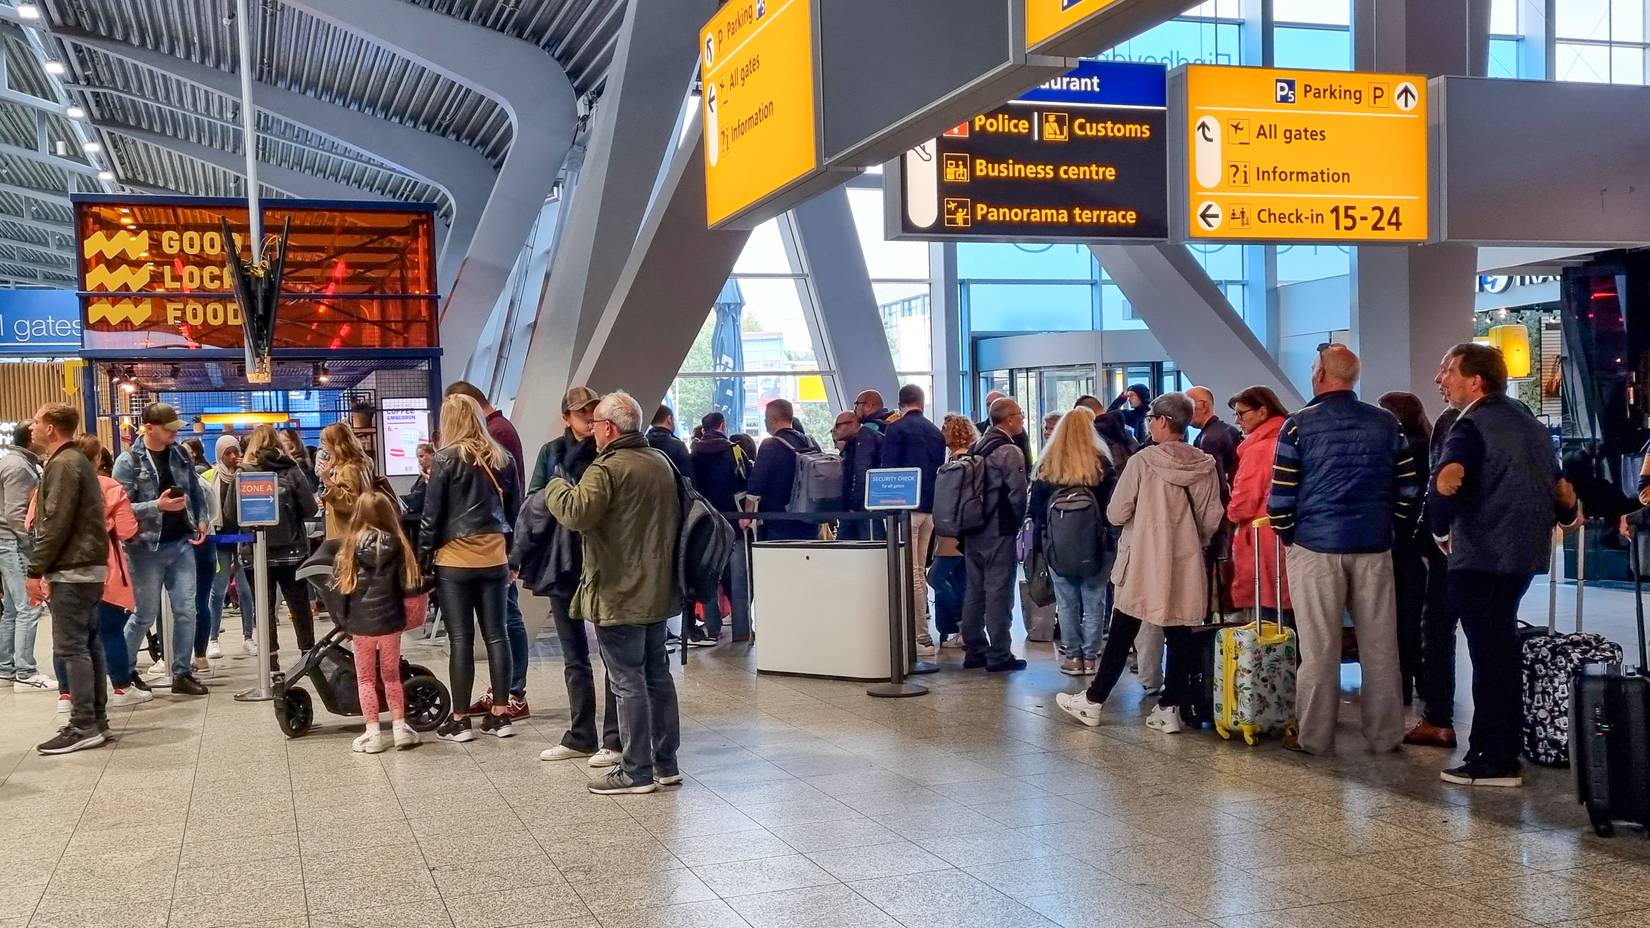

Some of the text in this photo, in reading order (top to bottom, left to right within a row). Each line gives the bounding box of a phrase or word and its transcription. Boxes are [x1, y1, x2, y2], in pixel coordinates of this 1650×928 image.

[727, 4, 753, 39] Parking
[729, 54, 760, 92] All gates
[1303, 83, 1363, 105] Parking
[731, 100, 774, 141] Information
[974, 114, 1151, 138] Police Customs
[1255, 123, 1327, 144] All gates
[975, 158, 1117, 181] Business centre
[1256, 166, 1351, 184] Information
[976, 203, 1138, 224] Panorama terrace
[1257, 205, 1403, 232] Check-in 15-24
[166, 302, 242, 326] FOOD
[14, 315, 81, 342] gates
[241, 484, 273, 493] ZONE A
